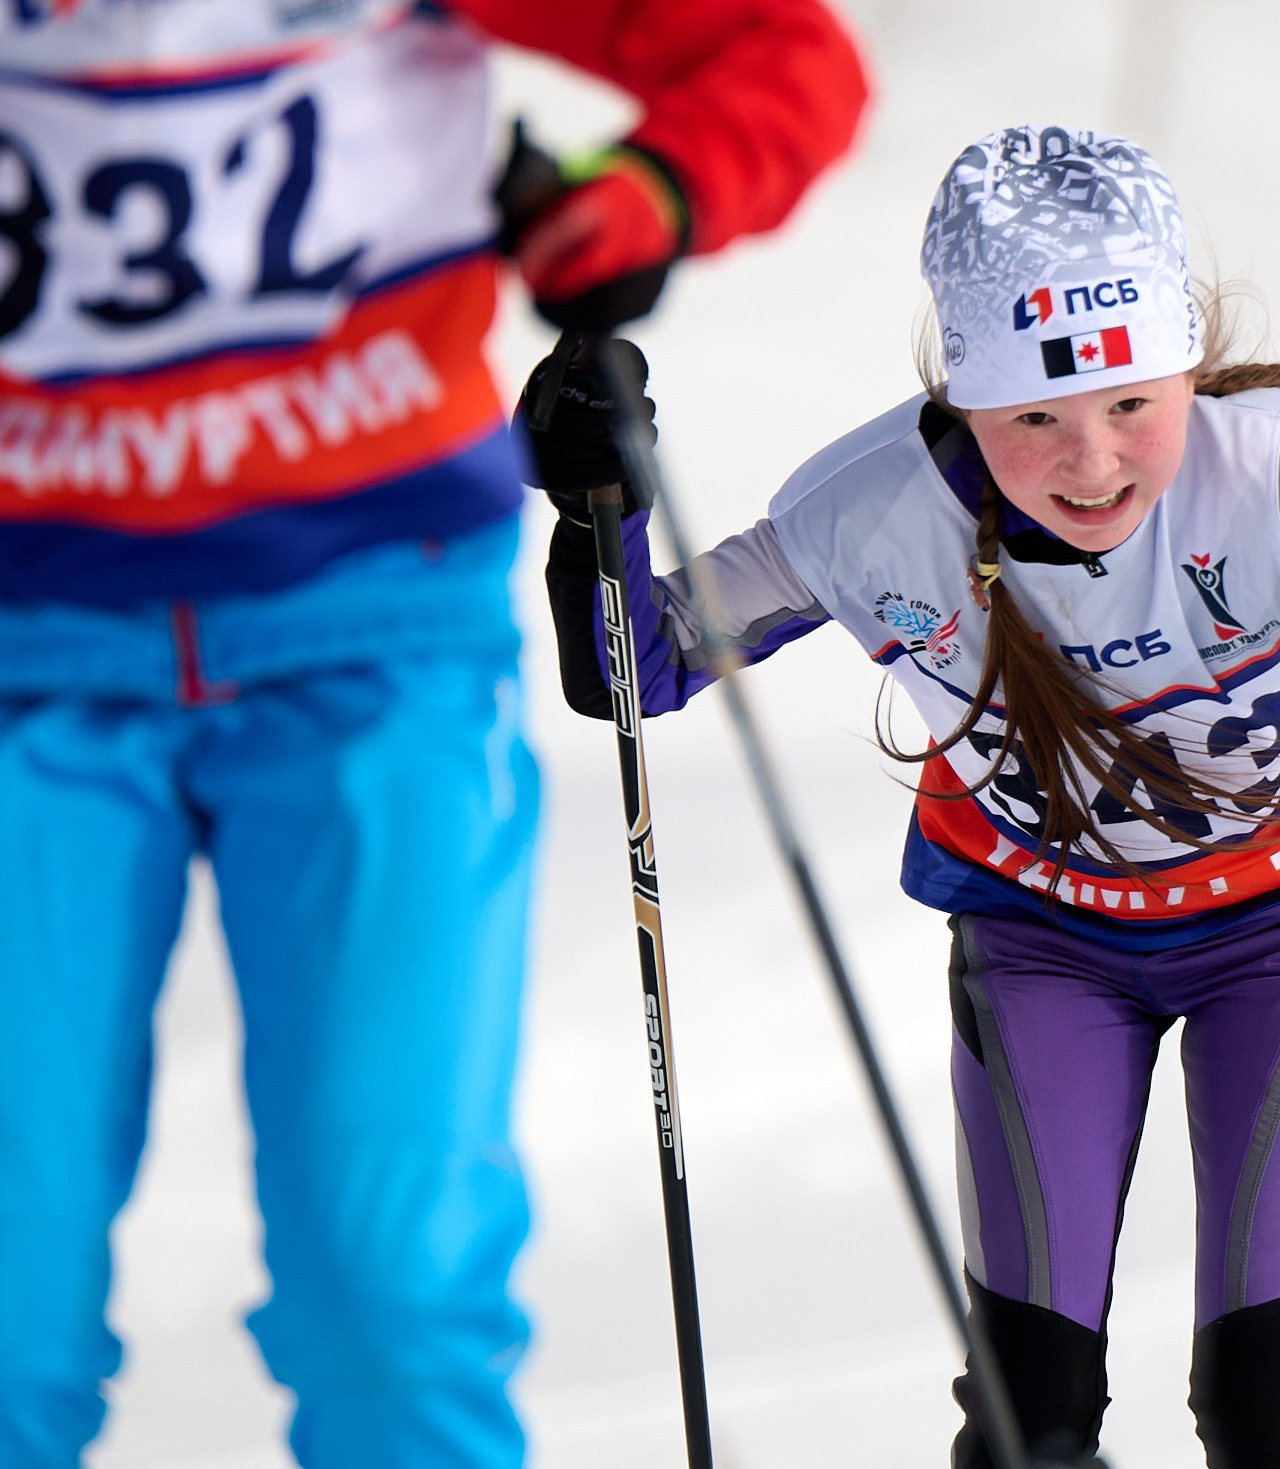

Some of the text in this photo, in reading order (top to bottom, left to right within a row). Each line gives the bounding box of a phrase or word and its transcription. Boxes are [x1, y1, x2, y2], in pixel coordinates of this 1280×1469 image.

[1064, 278, 1139, 316] ПСБ
[1059, 629, 1171, 673] ПСБ
[643, 993, 669, 1112] SPORT
